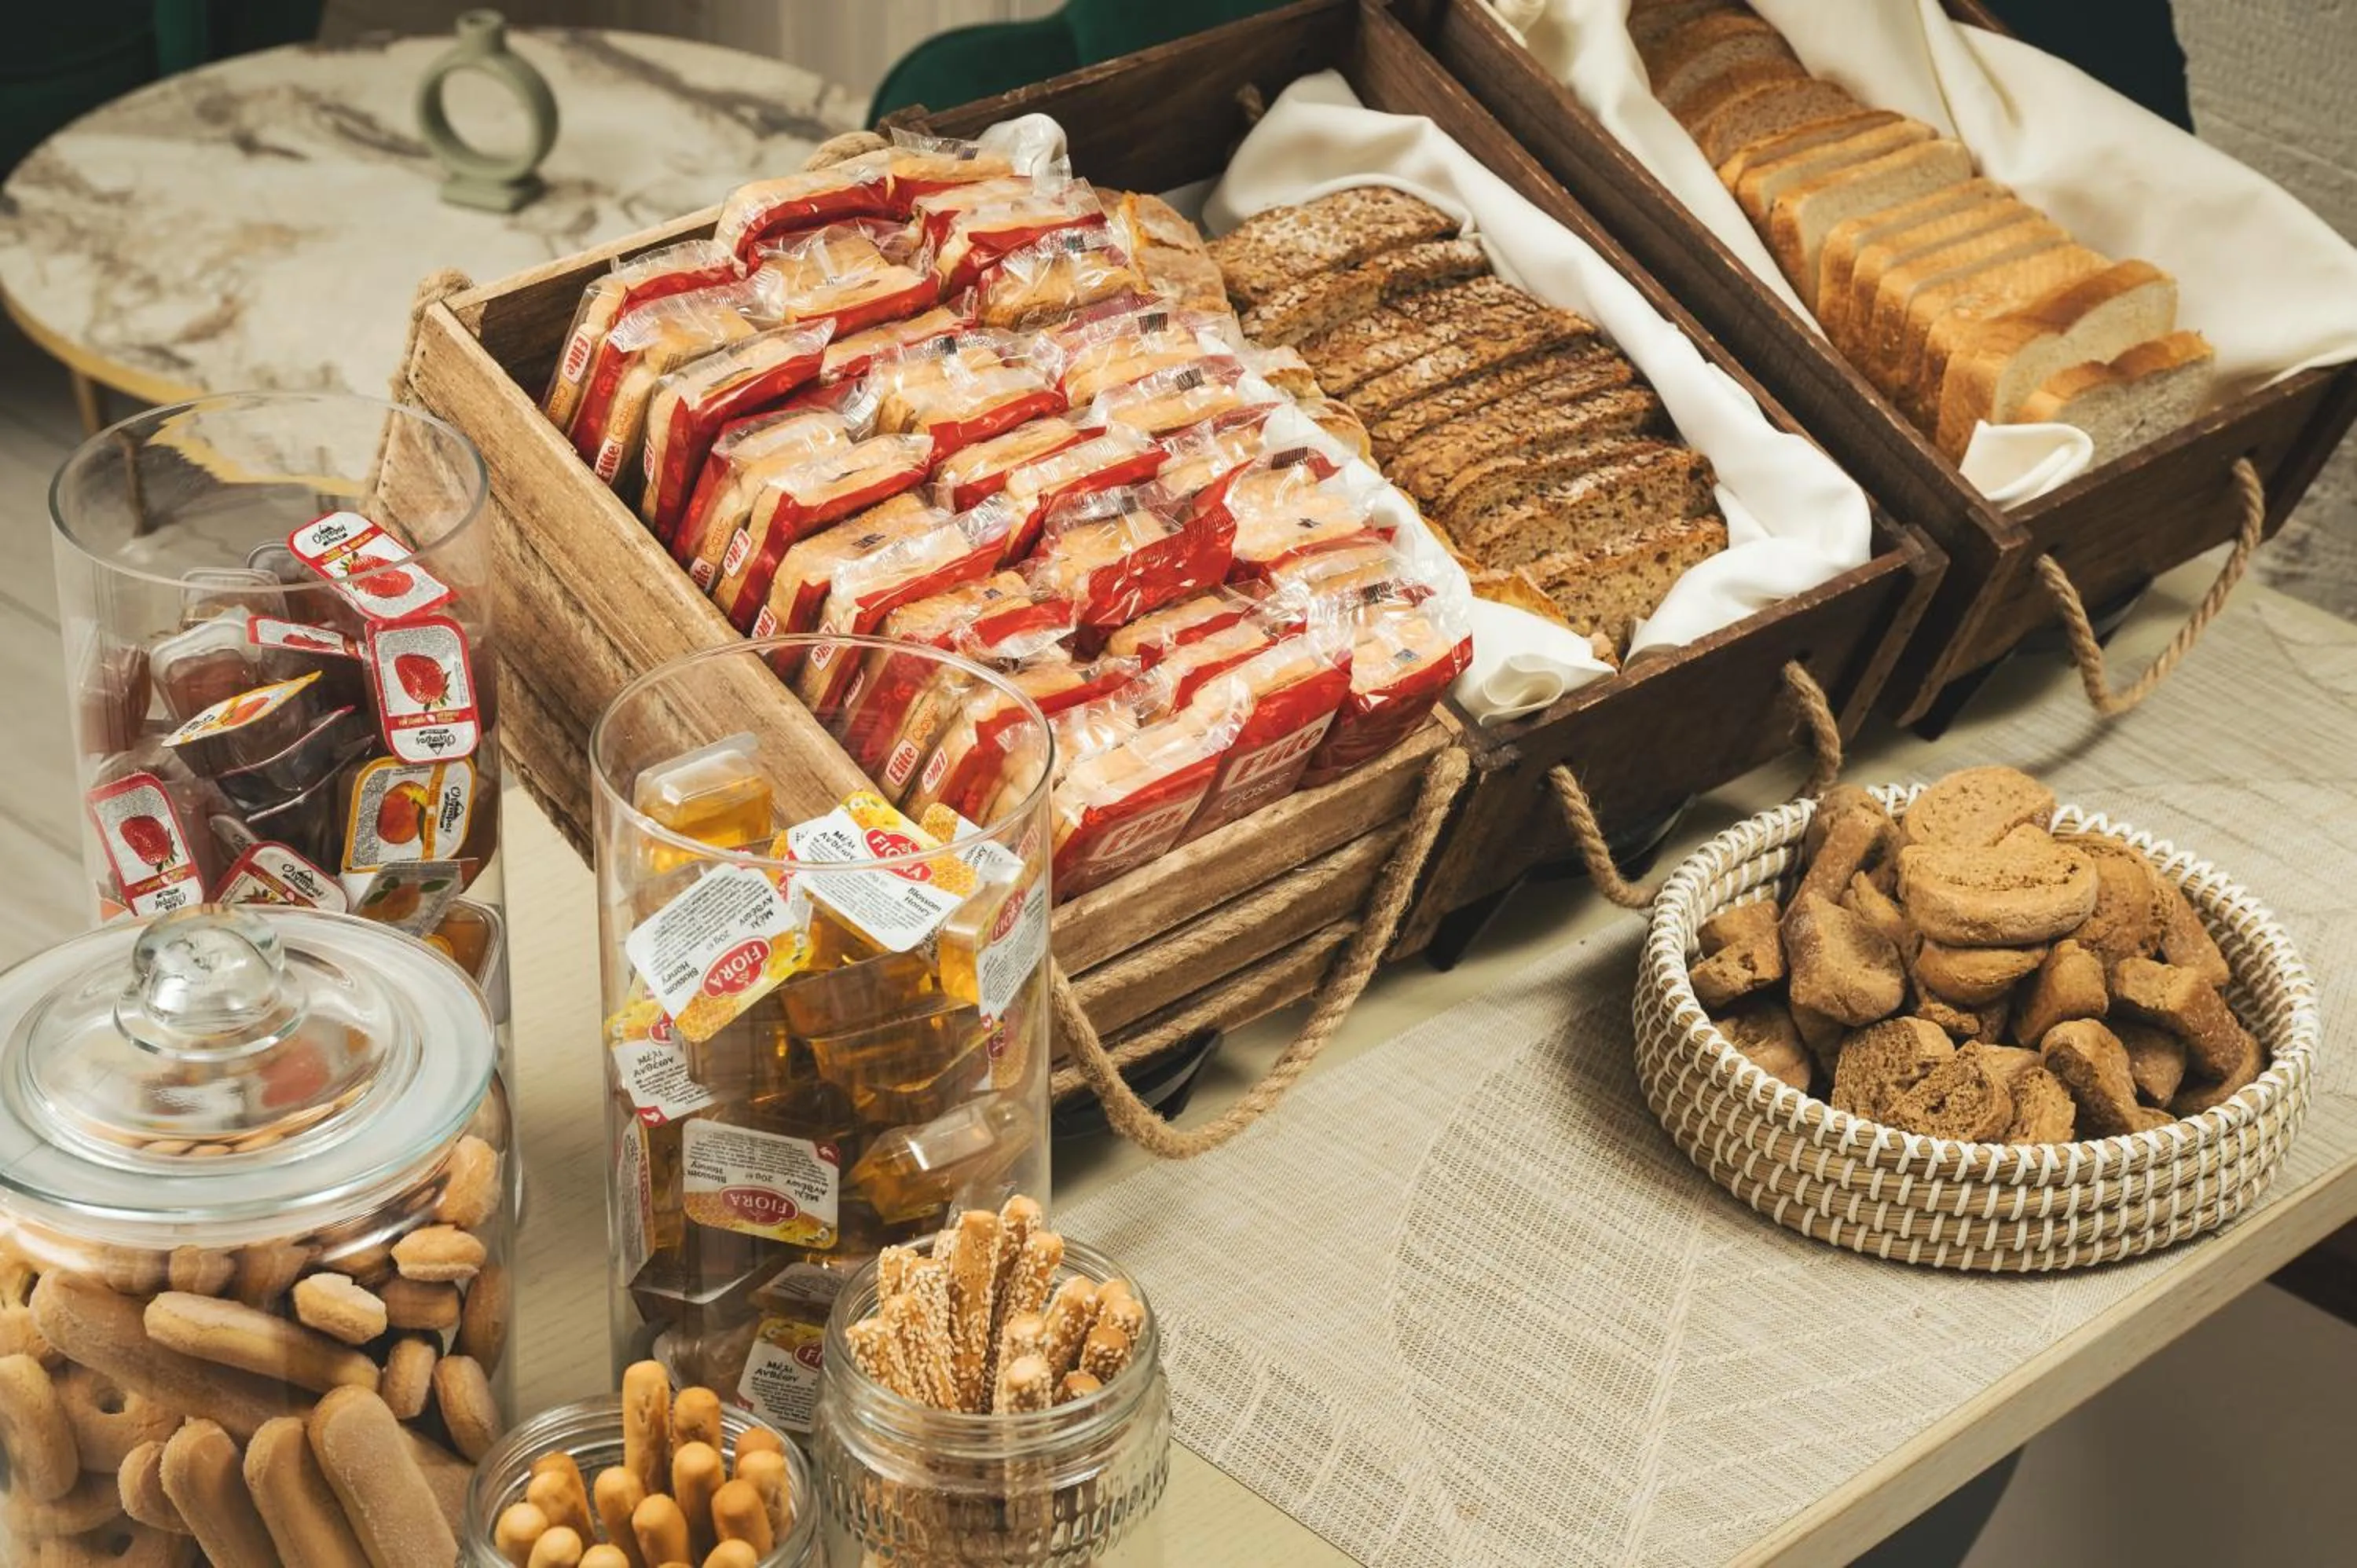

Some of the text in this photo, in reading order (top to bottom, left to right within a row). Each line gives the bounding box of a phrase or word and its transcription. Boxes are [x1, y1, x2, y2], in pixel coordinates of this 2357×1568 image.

[565, 335, 589, 376] Elite
[725, 529, 750, 570] Elite
[888, 746, 916, 783] Elite
[1230, 727, 1325, 784] Elite
[444, 786, 462, 833] Olympos
[871, 833, 924, 878] FIOA
[281, 863, 324, 897] Olympos
[904, 896, 933, 918] Honey
[907, 886, 943, 913] Blossom
[661, 960, 691, 985] Honey
[664, 966, 700, 996] Blossom
[708, 943, 763, 991] FIORA
[687, 1169, 728, 1185] Blossom
[691, 1159, 724, 1174] Honey
[754, 1171, 774, 1183] 20g
[729, 1192, 790, 1215] FIORA
